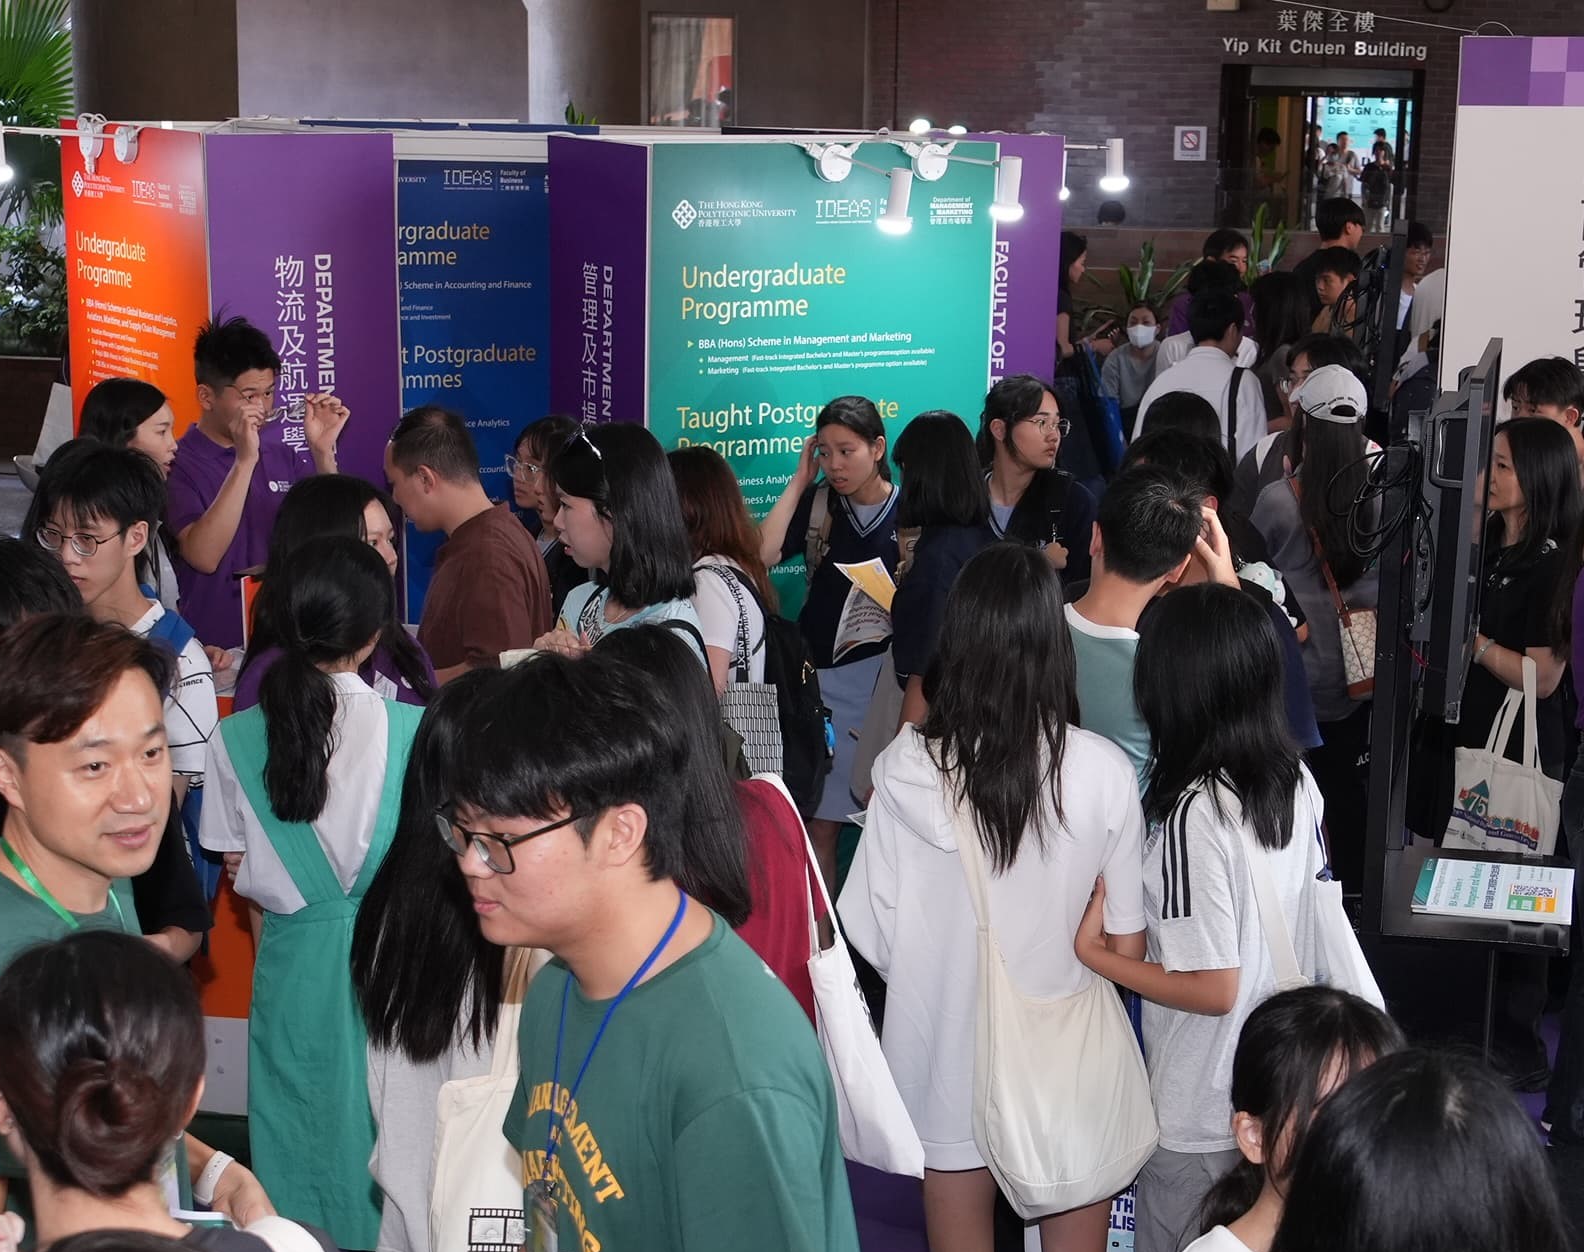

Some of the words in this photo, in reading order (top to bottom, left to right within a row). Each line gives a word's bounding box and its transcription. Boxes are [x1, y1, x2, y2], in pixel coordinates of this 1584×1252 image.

[1277, 10, 1376, 33] 葉傑全樓
[1222, 38, 1249, 56] Yip
[1258, 39, 1281, 53] Kit
[1290, 40, 1345, 55] Chuen
[1355, 41, 1427, 60] Building
[443, 170, 493, 185] IDEAS
[698, 210, 751, 218] POLYTECHNIC
[752, 209, 797, 217] UNIVERSITY
[699, 200, 714, 209] THE
[716, 200, 740, 209] HONG
[741, 200, 763, 208] KONG
[816, 199, 871, 218] IDEAS
[399, 221, 490, 245] rgraduate
[76, 230, 146, 261] Undergraduate
[398, 250, 457, 266] amme
[77, 259, 132, 288] Programme
[682, 262, 846, 293] Undergraduate
[404, 281, 434, 289] Scheme
[435, 281, 443, 289] in
[444, 281, 486, 291] Accounting
[488, 281, 502, 289] and
[503, 281, 532, 289] Finance
[993, 241, 1009, 335] FACULTY
[682, 297, 808, 325] Programme
[315, 254, 337, 400] DEPARTMEN
[602, 265, 613, 422] DEPARTMEN
[698, 339, 716, 349] BBA
[718, 338, 746, 349] (Hons)
[747, 336, 782, 347] Scheme
[783, 336, 791, 345] in
[793, 334, 849, 346] Management
[851, 332, 867, 343] and
[869, 332, 912, 344] Marketing
[275, 255, 309, 453] 物流及航運學
[414, 343, 536, 368] Postgraduate
[707, 355, 749, 364] Management
[991, 341, 1006, 369] OF
[405, 374, 462, 389] mmes
[707, 367, 739, 375] Marketing
[477, 419, 511, 428] Analytics
[677, 402, 752, 433] Taught
[758, 398, 899, 429] Postgrte
[677, 437, 804, 459] Programme
[479, 465, 507, 474] ccounti
[737, 476, 764, 487] siness
[737, 639, 746, 670] NEXT
